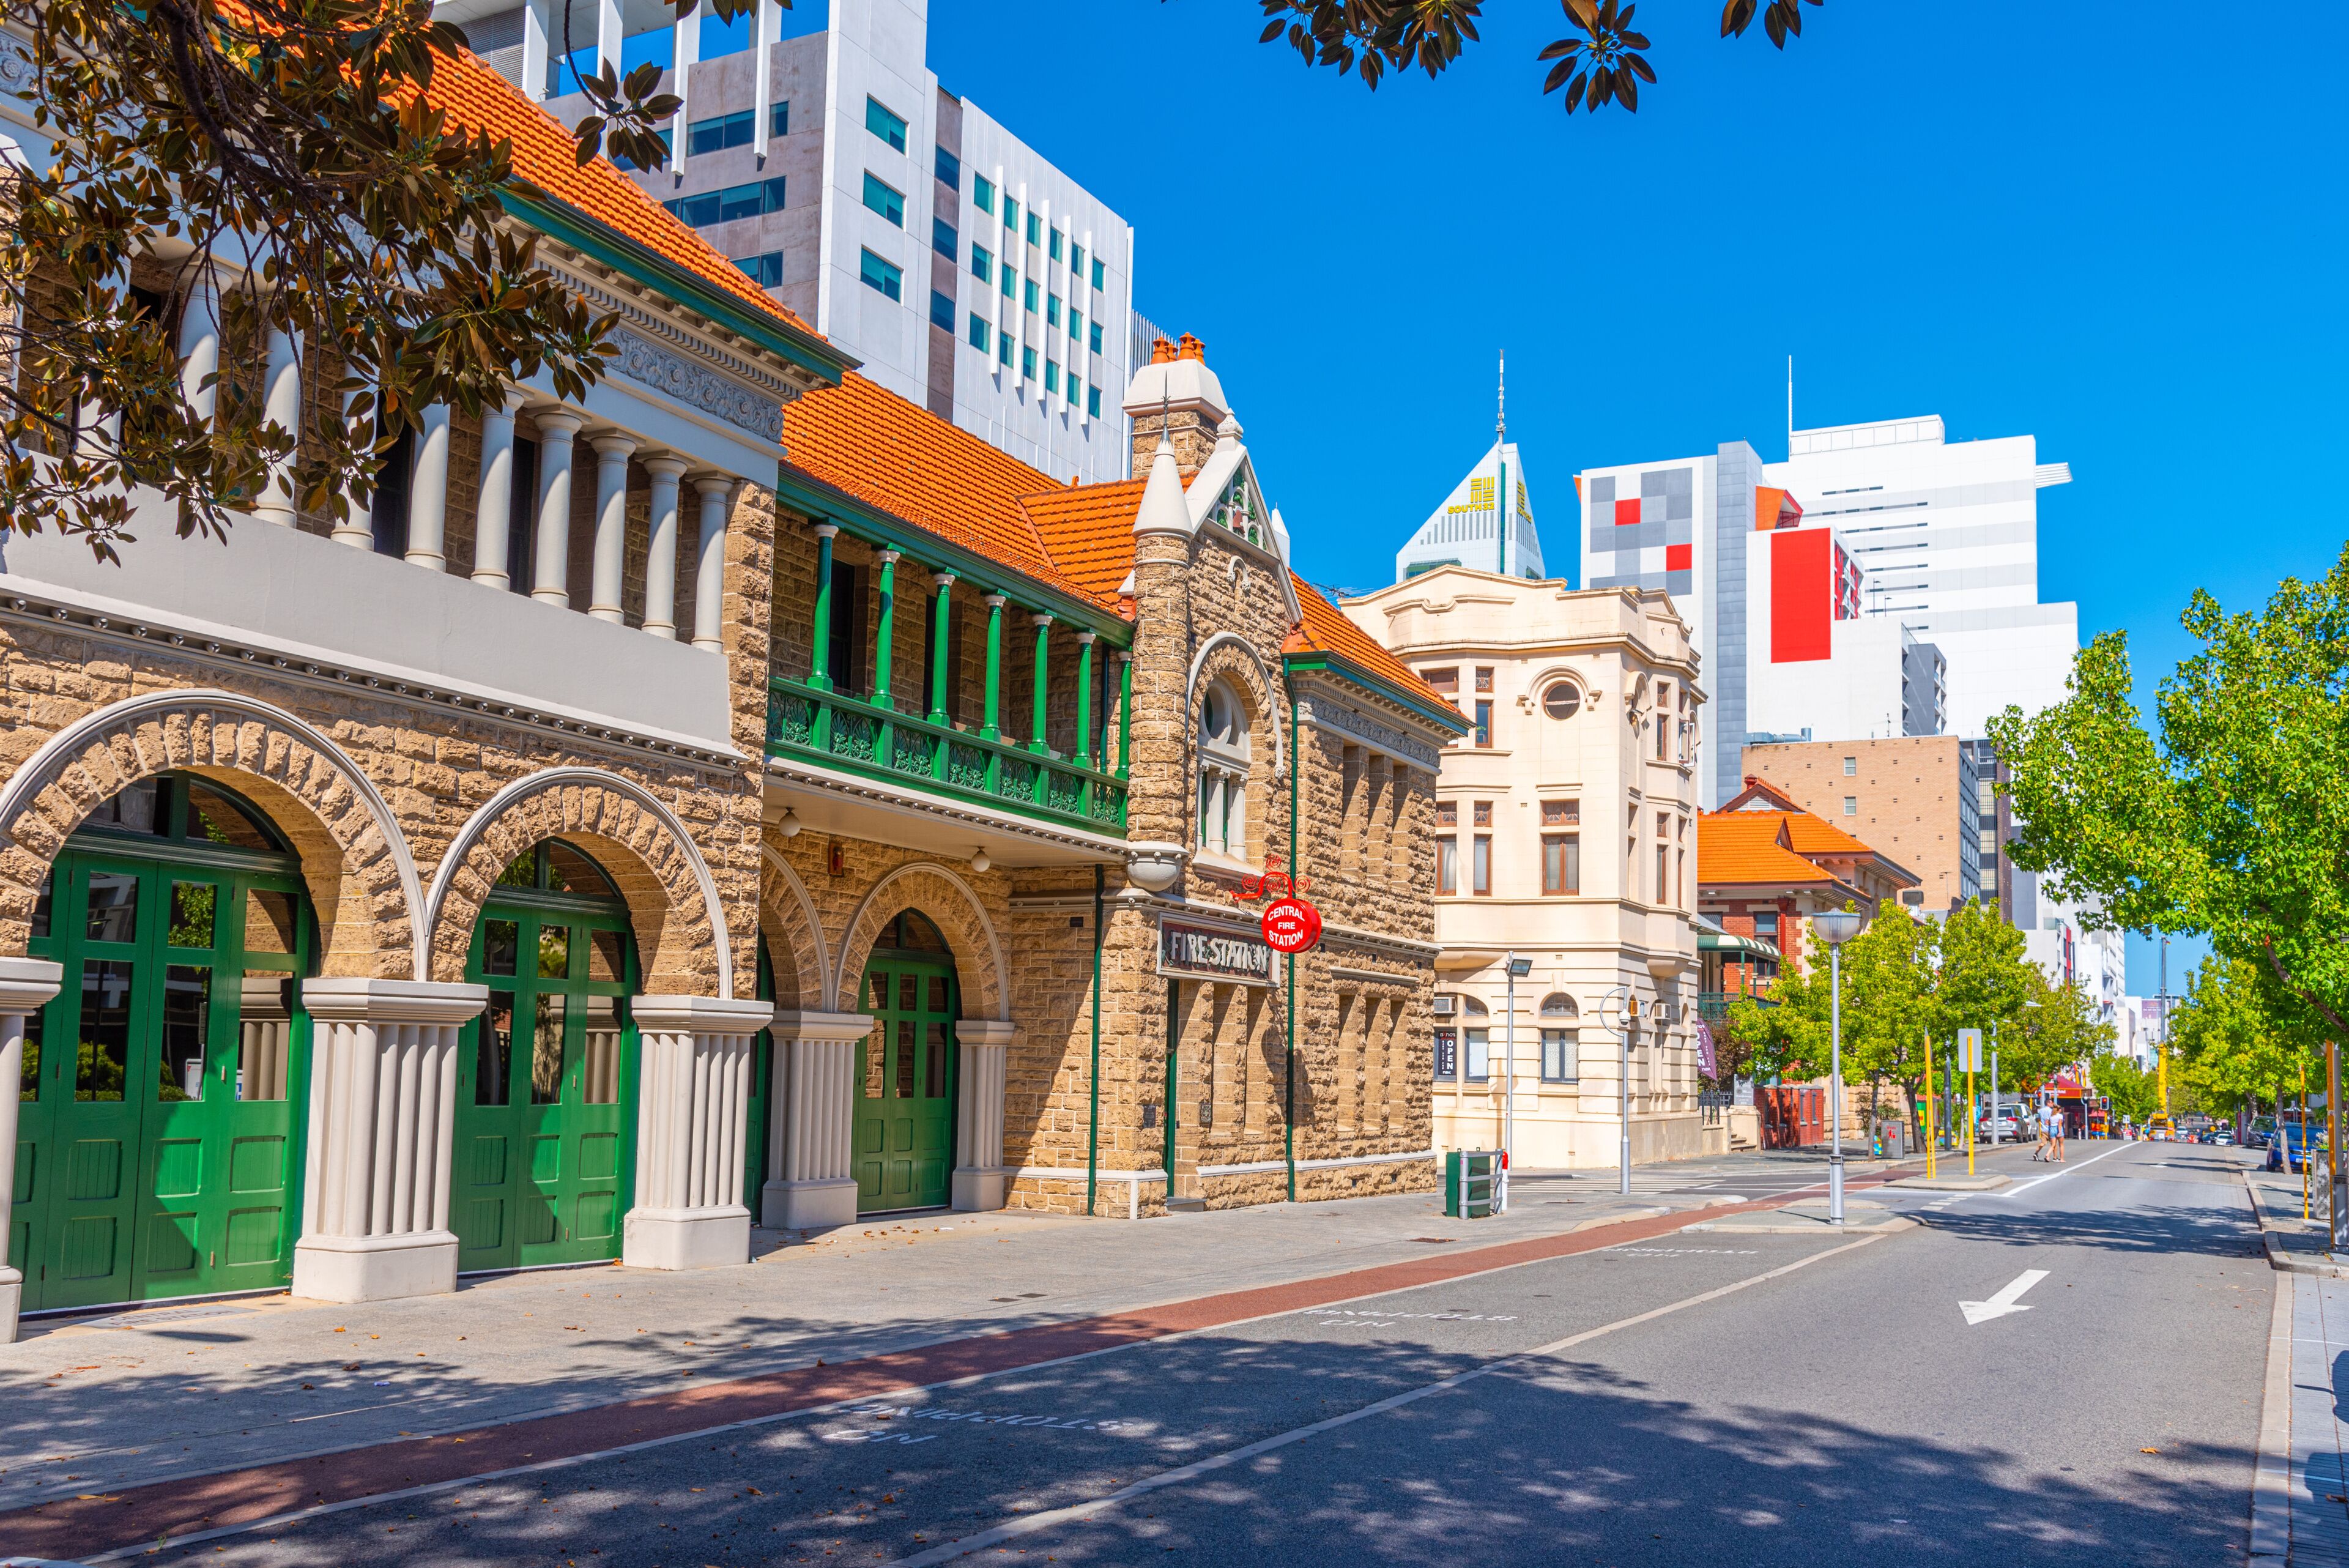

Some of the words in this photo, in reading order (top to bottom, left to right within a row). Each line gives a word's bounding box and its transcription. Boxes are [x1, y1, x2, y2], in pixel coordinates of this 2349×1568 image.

[1447, 502, 1495, 514] SOUTH32
[1268, 905, 1305, 922] CENTRAL
[1269, 929, 1304, 946] STATION
[1171, 931, 1208, 963] FIRE
[1209, 937, 1267, 972] STATION
[109, 1309, 198, 1321] CENTRAL
[1304, 1309, 1518, 1321] STOPPING
[837, 1404, 1134, 1431] STOPPING
[822, 1429, 937, 1444] NO
